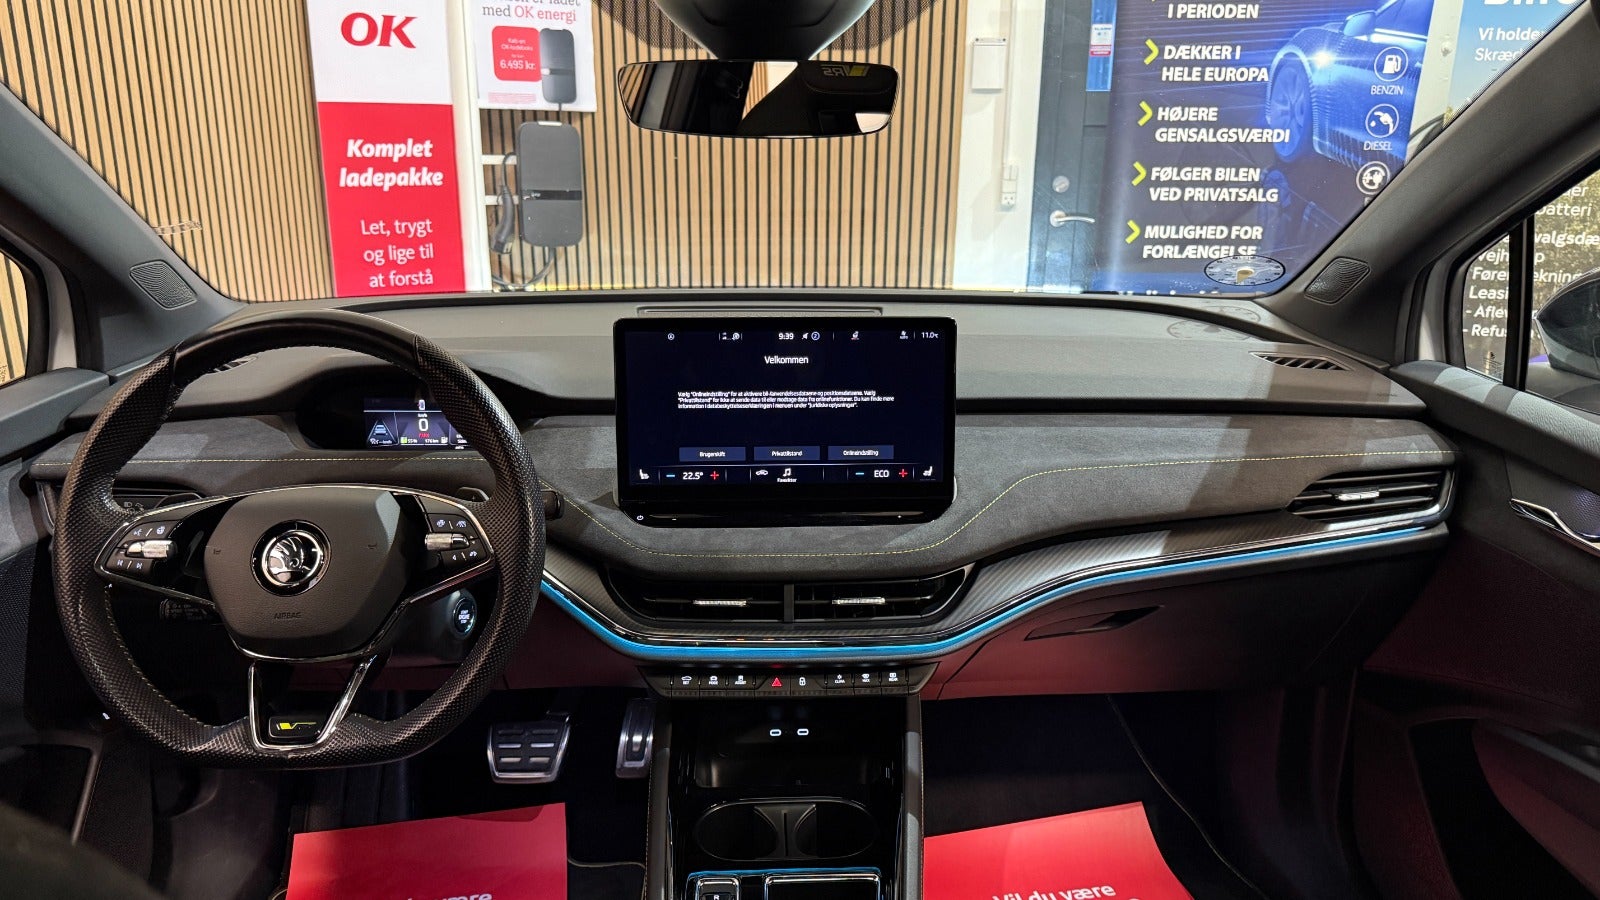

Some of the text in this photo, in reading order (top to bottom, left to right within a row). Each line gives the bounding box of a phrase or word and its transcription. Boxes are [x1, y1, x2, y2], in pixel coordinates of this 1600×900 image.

[482, 5, 577, 24] med OK energi
[1168, 3, 1259, 19] I PERIODEN
[340, 12, 417, 48] OK
[1478, 27, 1543, 41] Vi holde
[1163, 45, 1241, 61] DÆKKER I
[499, 59, 524, 70] 6.495
[1161, 67, 1269, 82] HELE EUROPA
[1370, 85, 1404, 96] BENZIN
[1157, 106, 1218, 122] HØJERE
[1155, 127, 1290, 143] GENSALGSVÆRDI
[347, 138, 433, 163] Komplet
[1363, 140, 1393, 151] DIESEL
[339, 167, 443, 192] ladepakke
[1151, 166, 1261, 182] FØLGER BILEN
[1149, 187, 1279, 203] VED PRIVATSALG
[361, 219, 432, 239] Let, trygt
[1144, 225, 1263, 240] MULIGHED FOR
[363, 243, 434, 266] og lige til
[369, 267, 433, 288] at forstå
[1469, 285, 1509, 300] Leasi
[778, 332, 794, 340] 9:39
[764, 355, 809, 364] Velkommen
[419, 418, 429, 431] 0
[682, 471, 704, 480] 22.5°
[874, 469, 890, 478] ECO
[1058, 884, 1117, 900] være
